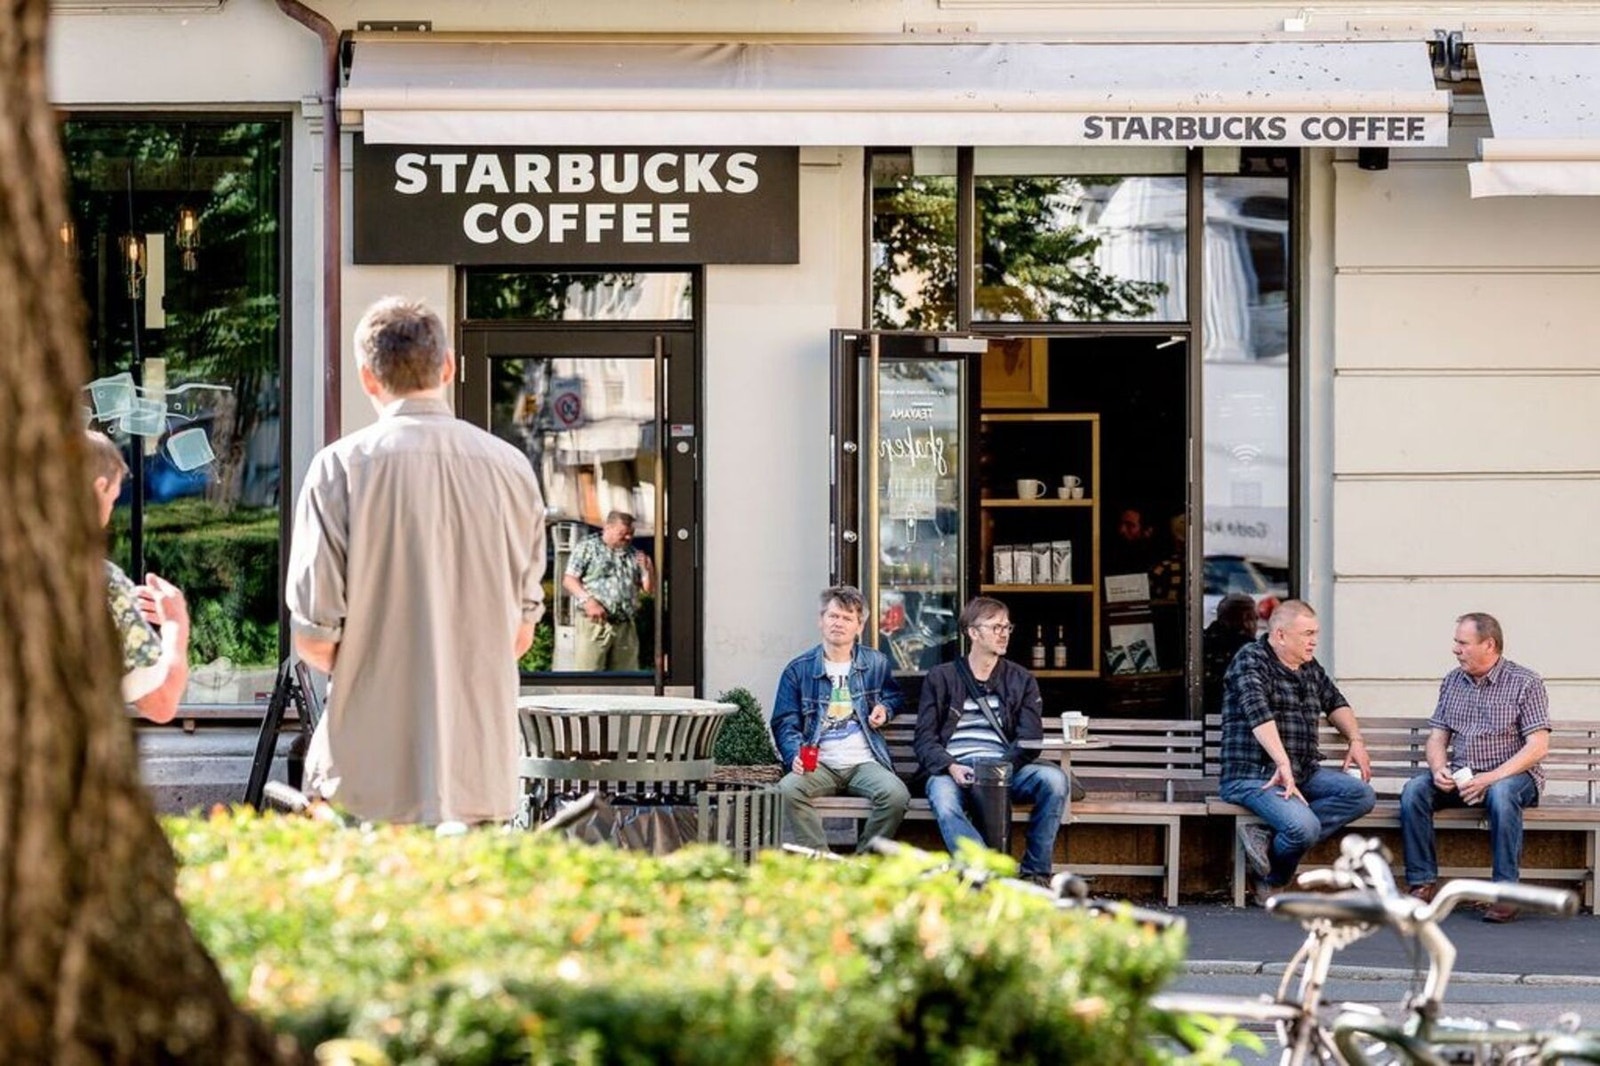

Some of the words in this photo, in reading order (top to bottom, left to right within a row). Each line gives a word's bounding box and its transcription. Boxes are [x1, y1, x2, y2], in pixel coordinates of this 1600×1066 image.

[1083, 116, 1287, 141] STARBUCKS
[1300, 116, 1425, 141] COFFEE
[394, 152, 759, 194] STARBUCKS
[463, 203, 690, 244] COFFEE
